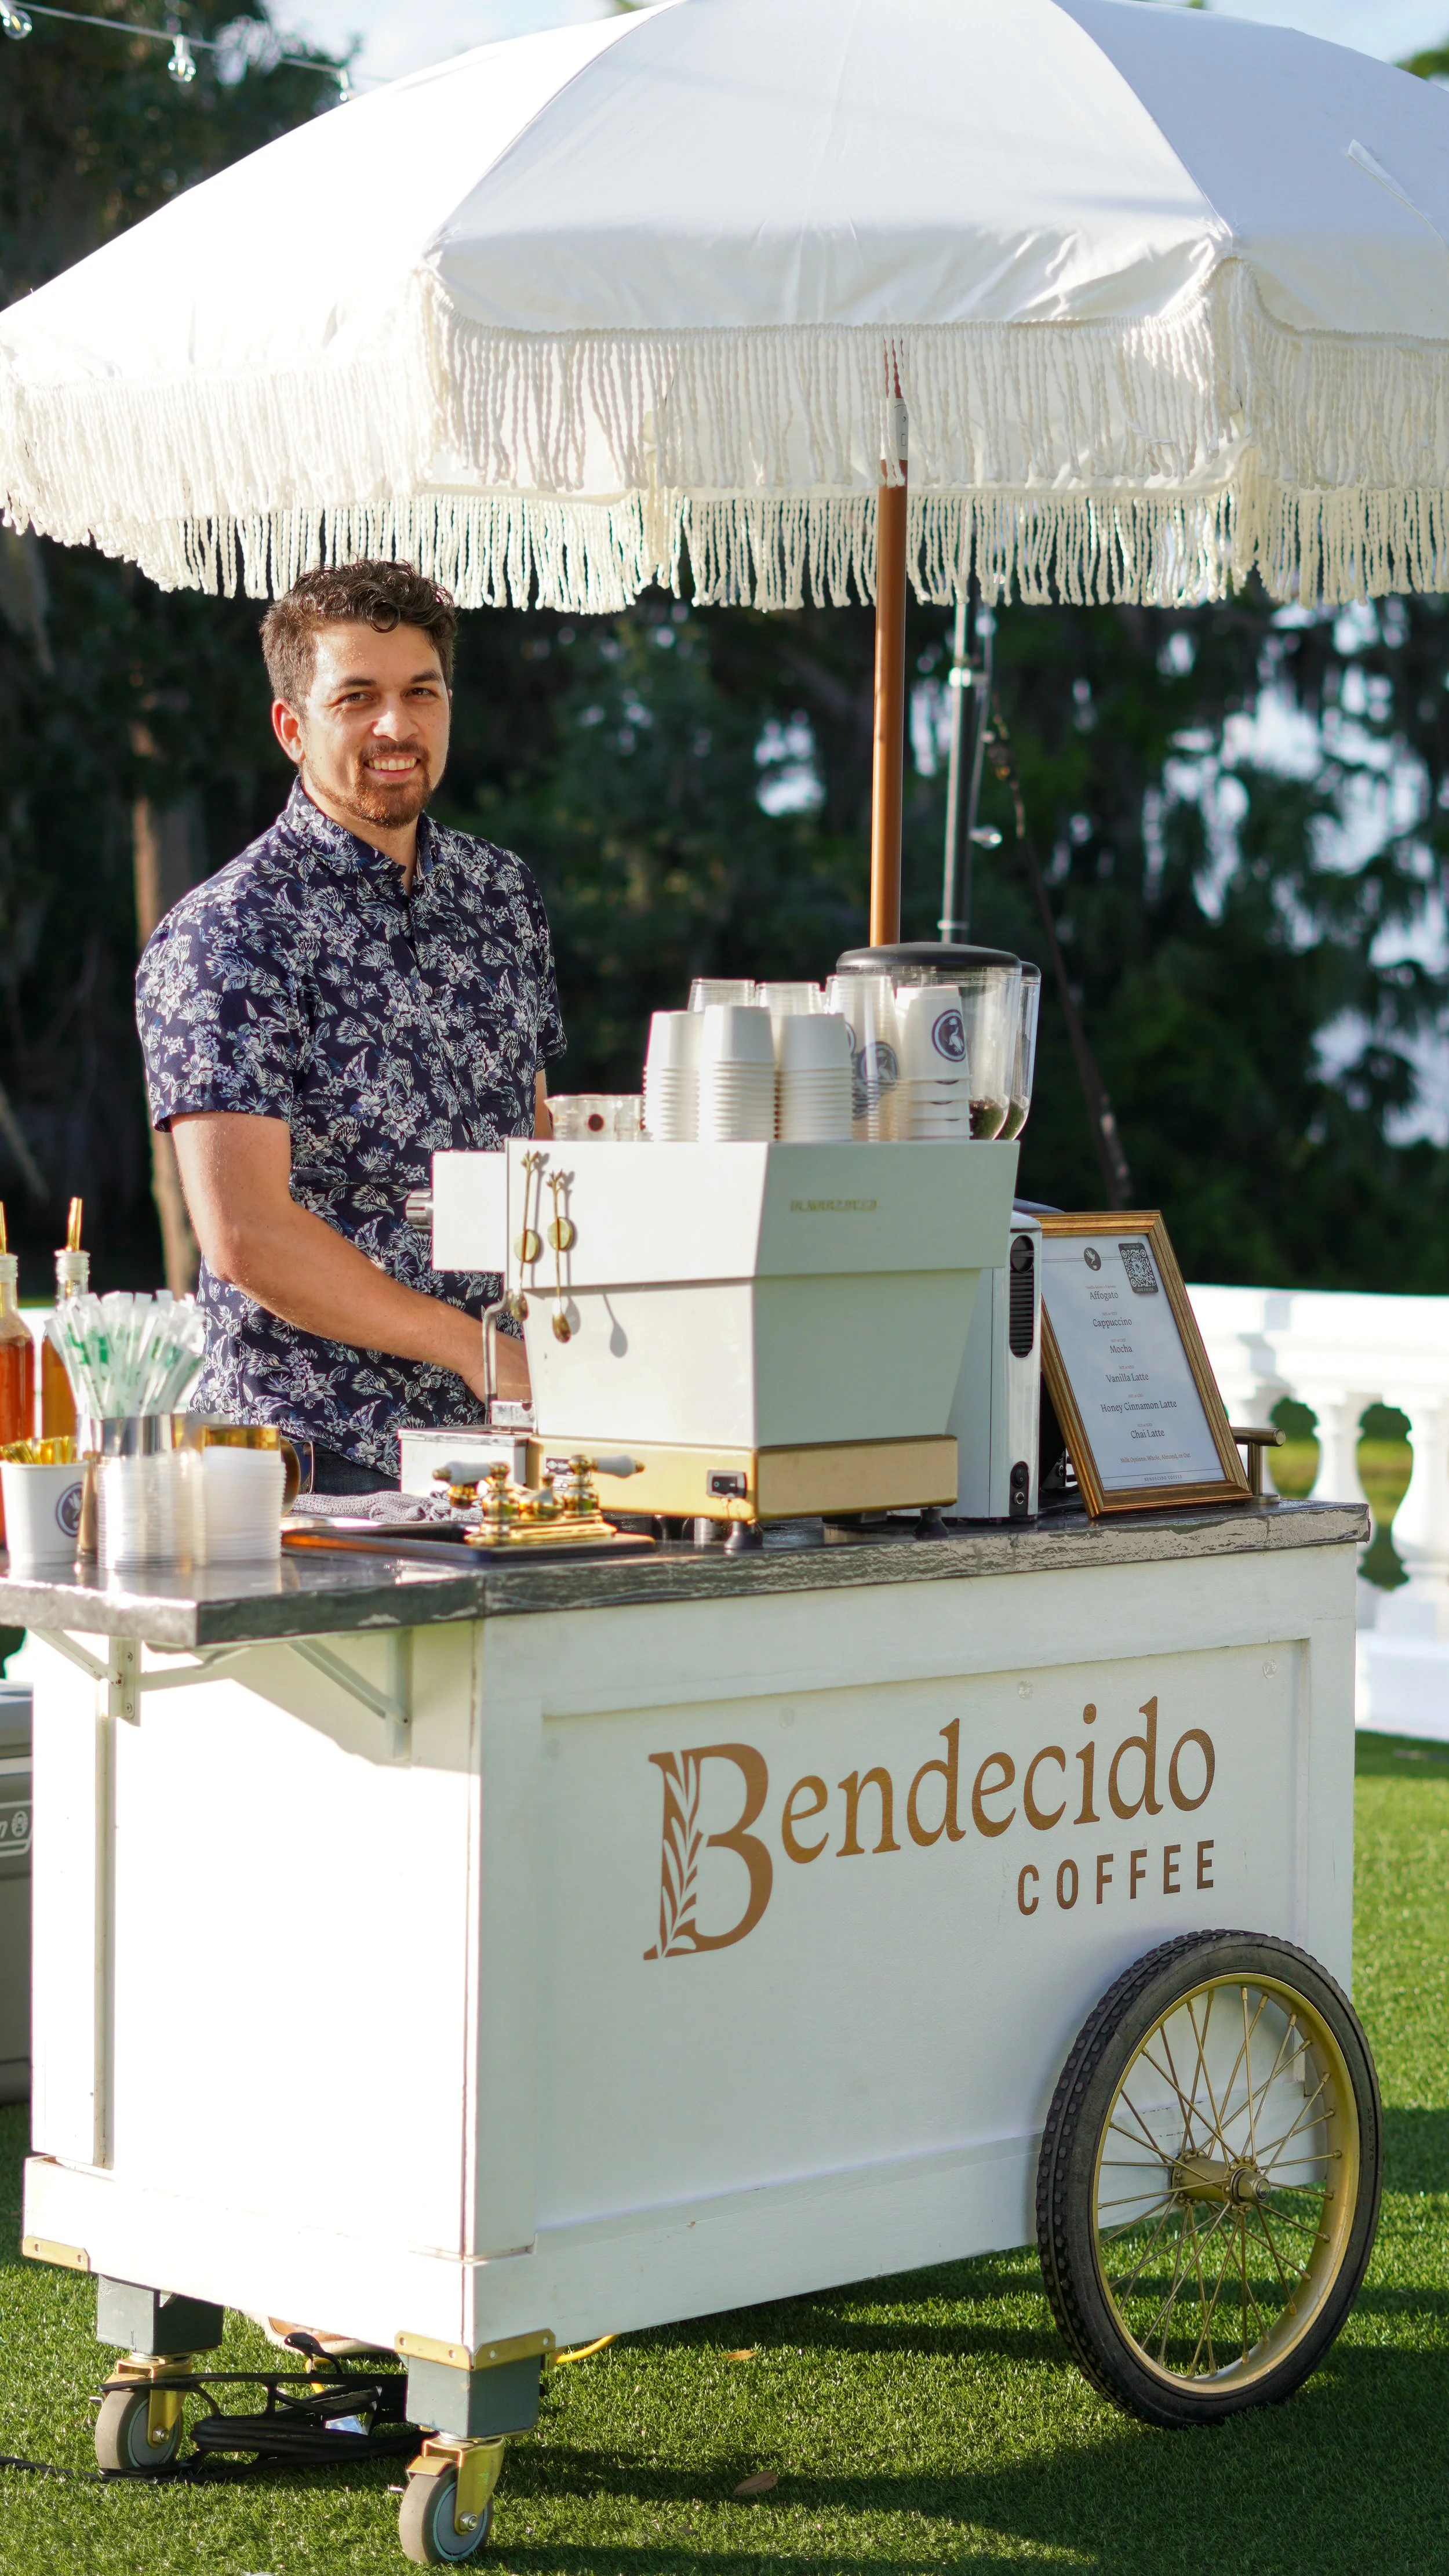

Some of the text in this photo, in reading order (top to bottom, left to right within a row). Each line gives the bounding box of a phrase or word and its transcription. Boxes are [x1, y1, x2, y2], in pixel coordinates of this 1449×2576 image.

[1090, 1291, 1119, 1302] Affogato
[1093, 1317, 1133, 1329] Cappuccino
[1110, 1344, 1133, 1353] Mocha
[1105, 1373, 1149, 1383] Vanilla Latte
[1100, 1400, 1177, 1414] Honey Cinnamon Latte
[1131, 1429, 1165, 1438] Chai Latte
[643, 1695, 1215, 1960] Bendecido
[1018, 1839, 1214, 1916] COFFEE
